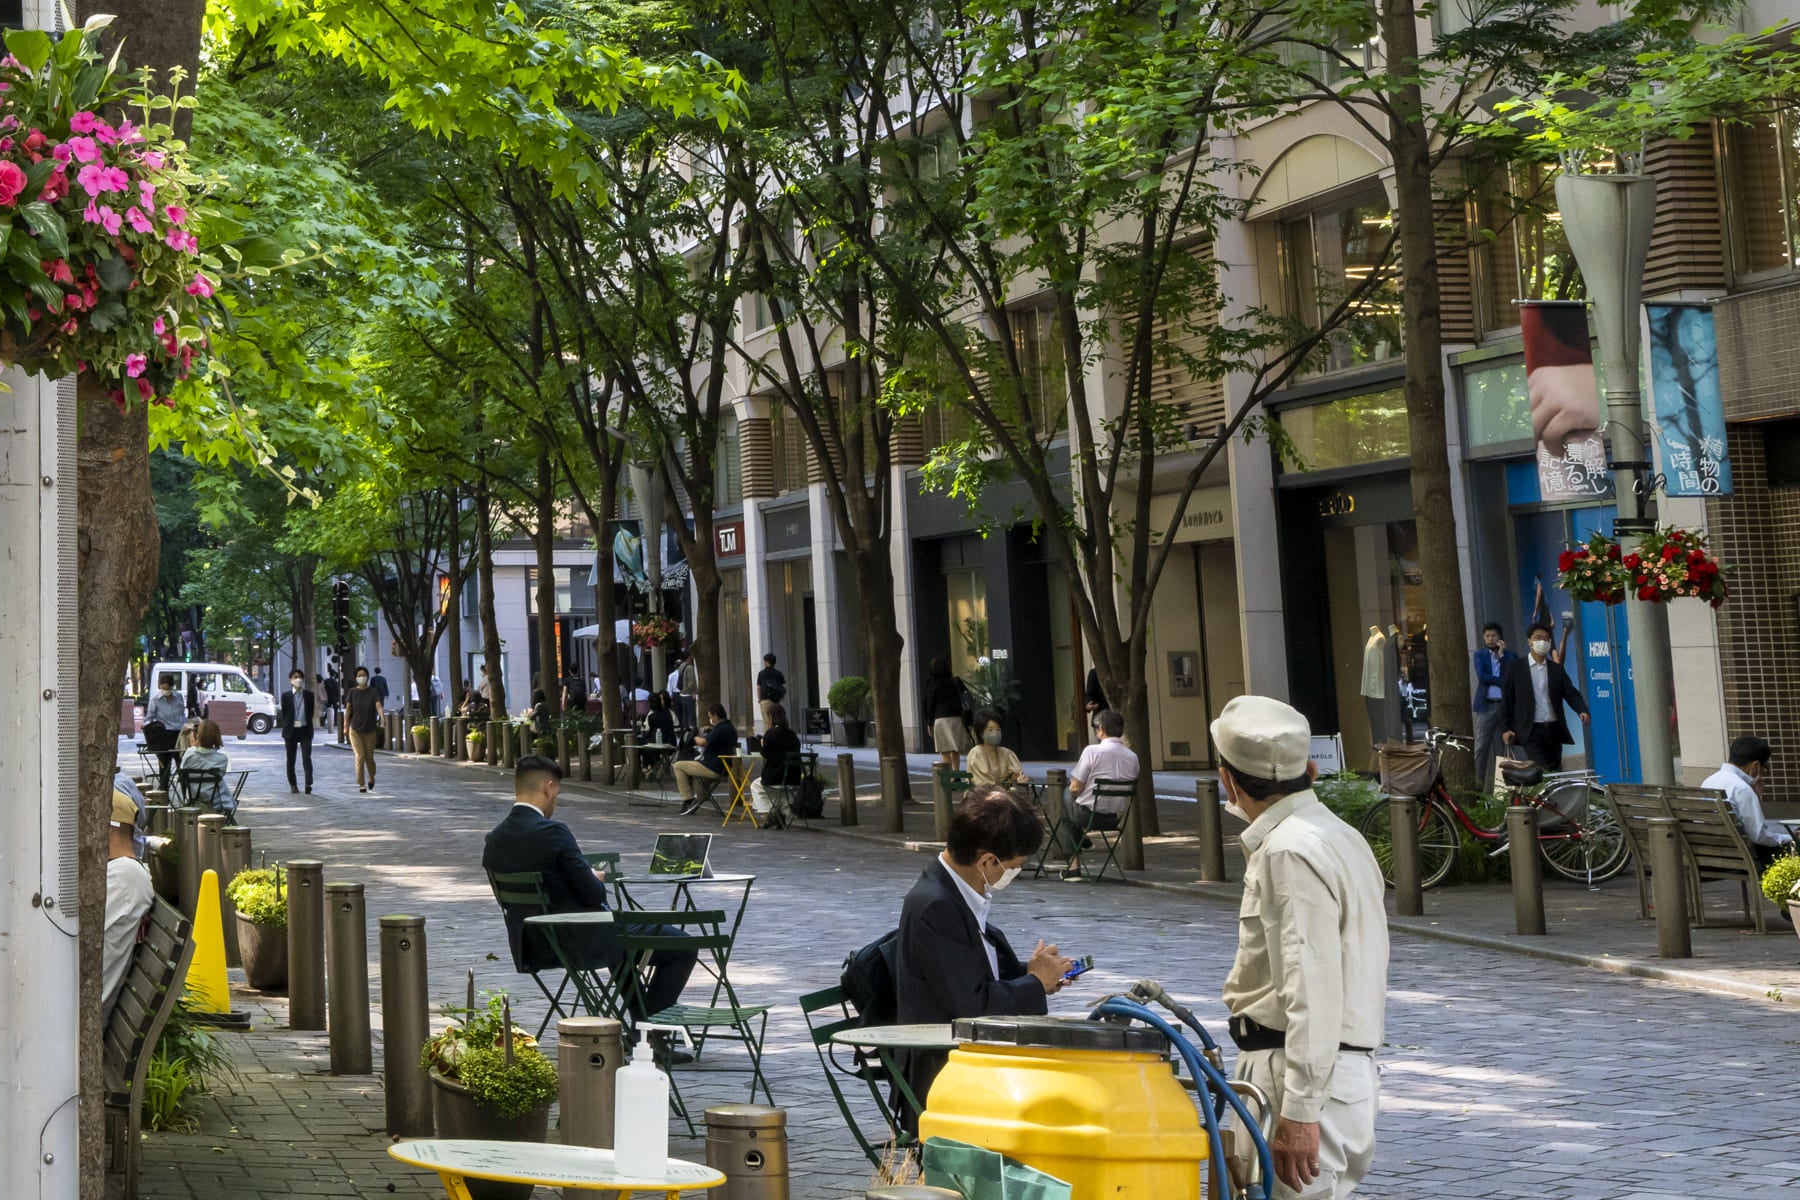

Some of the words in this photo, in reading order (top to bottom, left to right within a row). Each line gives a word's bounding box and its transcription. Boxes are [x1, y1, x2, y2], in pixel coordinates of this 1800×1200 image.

[1541, 449, 1566, 493] 記憶
[1561, 443, 1584, 484] 還る
[1584, 438, 1608, 494] 分解し
[1670, 451, 1701, 491] 時間
[1699, 434, 1724, 493] 植物の
[1589, 641, 1610, 657] HOKA
